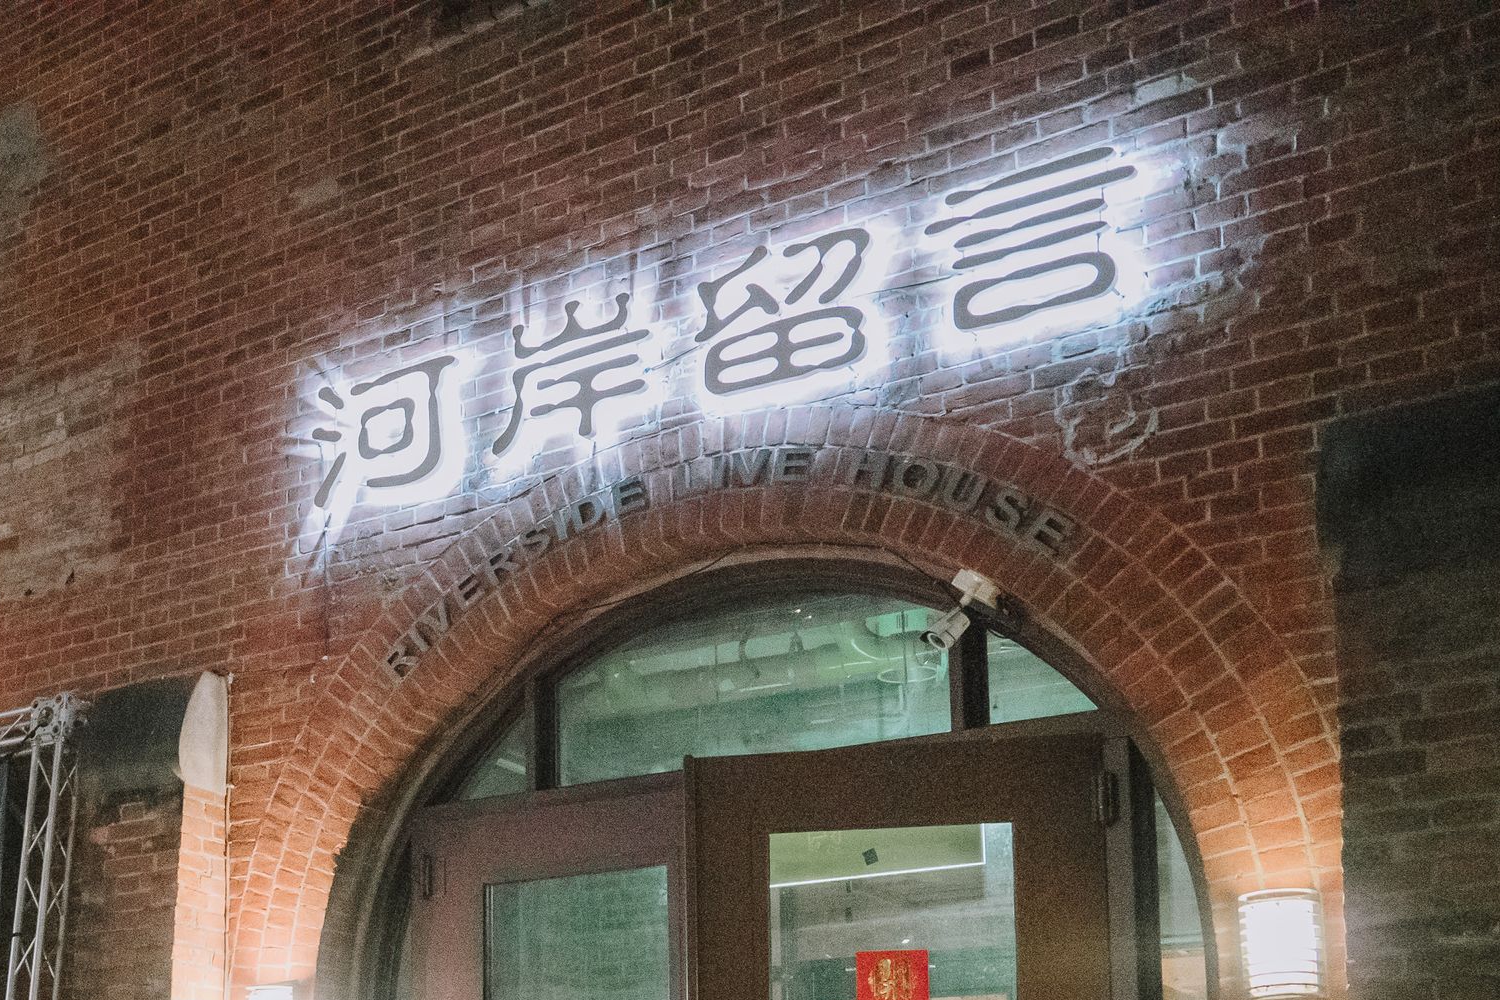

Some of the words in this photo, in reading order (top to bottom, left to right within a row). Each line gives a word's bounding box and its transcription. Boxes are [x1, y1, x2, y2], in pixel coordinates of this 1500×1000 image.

[312, 145, 1138, 509] 河岸留言
[380, 476, 647, 684] RIVERSIDE
[677, 447, 816, 491] LIVE
[849, 449, 1077, 555] HOUSE
